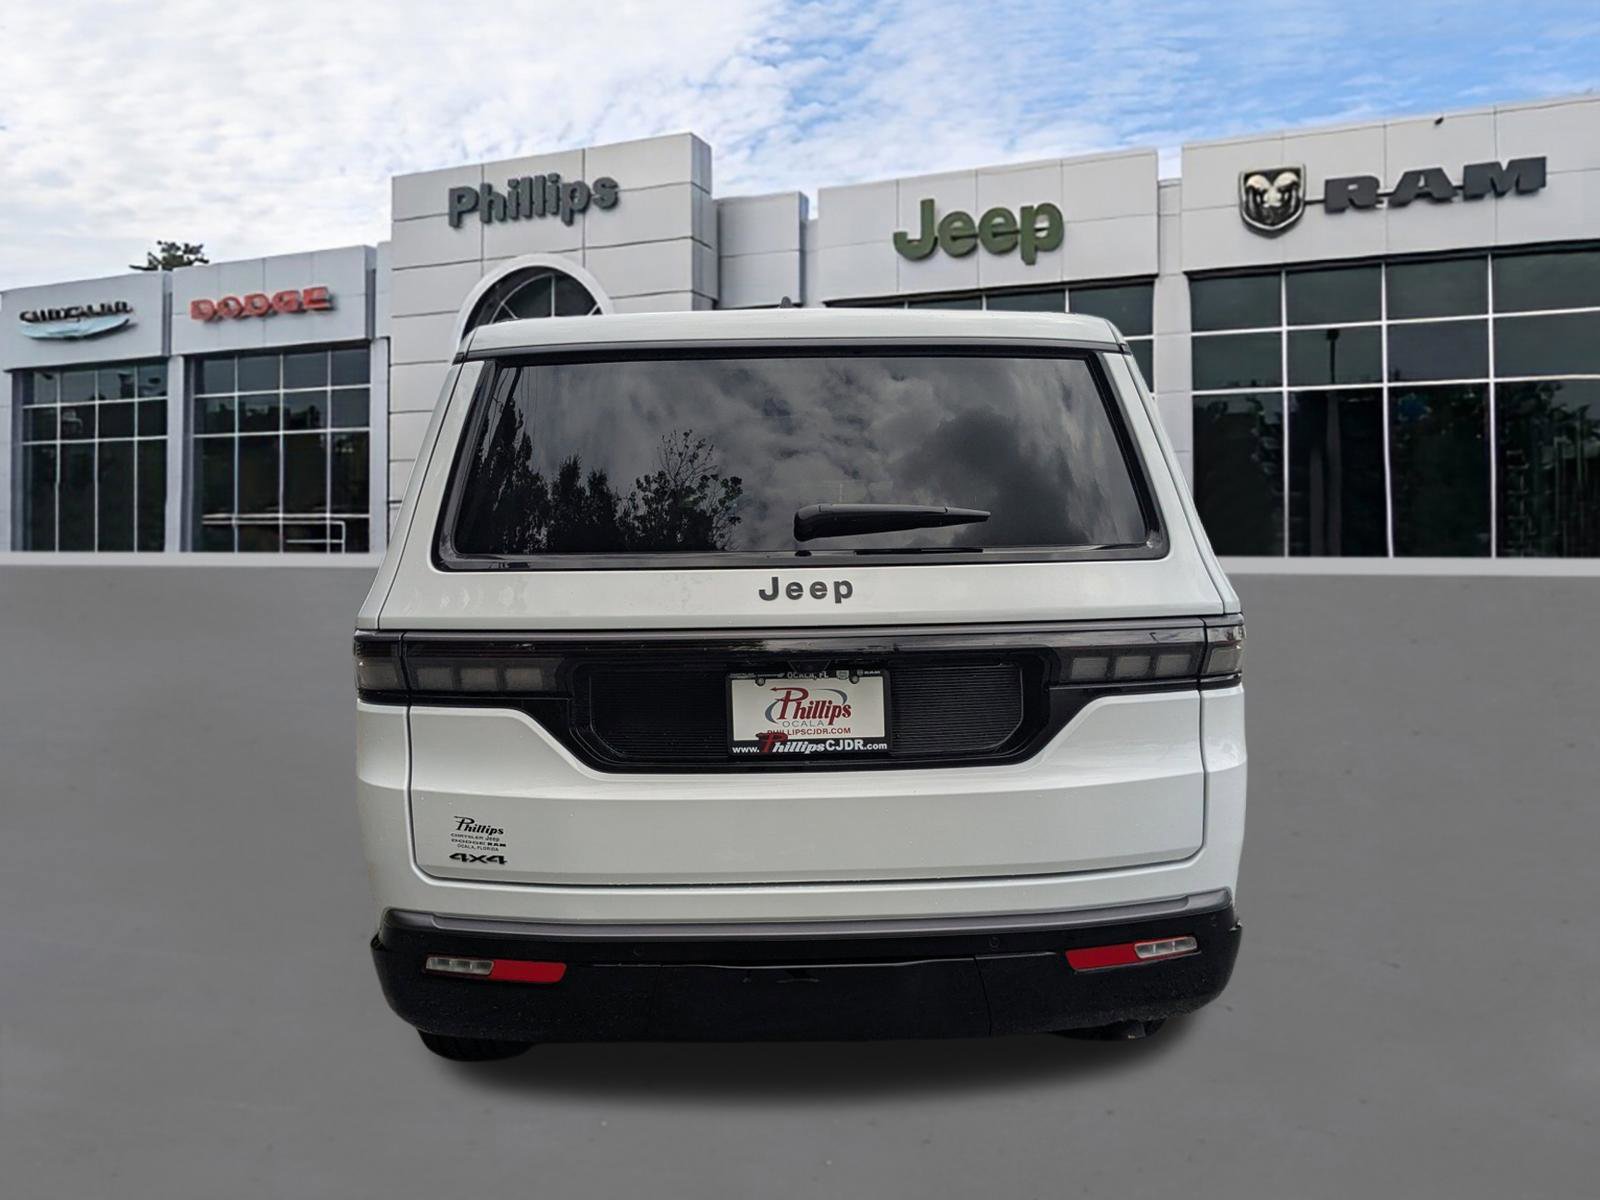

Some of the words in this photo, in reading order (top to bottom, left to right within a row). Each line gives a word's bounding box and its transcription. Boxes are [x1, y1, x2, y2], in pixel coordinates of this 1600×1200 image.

[448, 172, 619, 228] Phillips
[1324, 156, 1547, 214] RAM
[893, 198, 1064, 266] Jeep
[190, 286, 334, 323] DODGE
[758, 576, 853, 604] Jeep
[770, 686, 852, 726] Phillips
[782, 720, 825, 728] OCALA
[454, 815, 504, 835] Phillips
